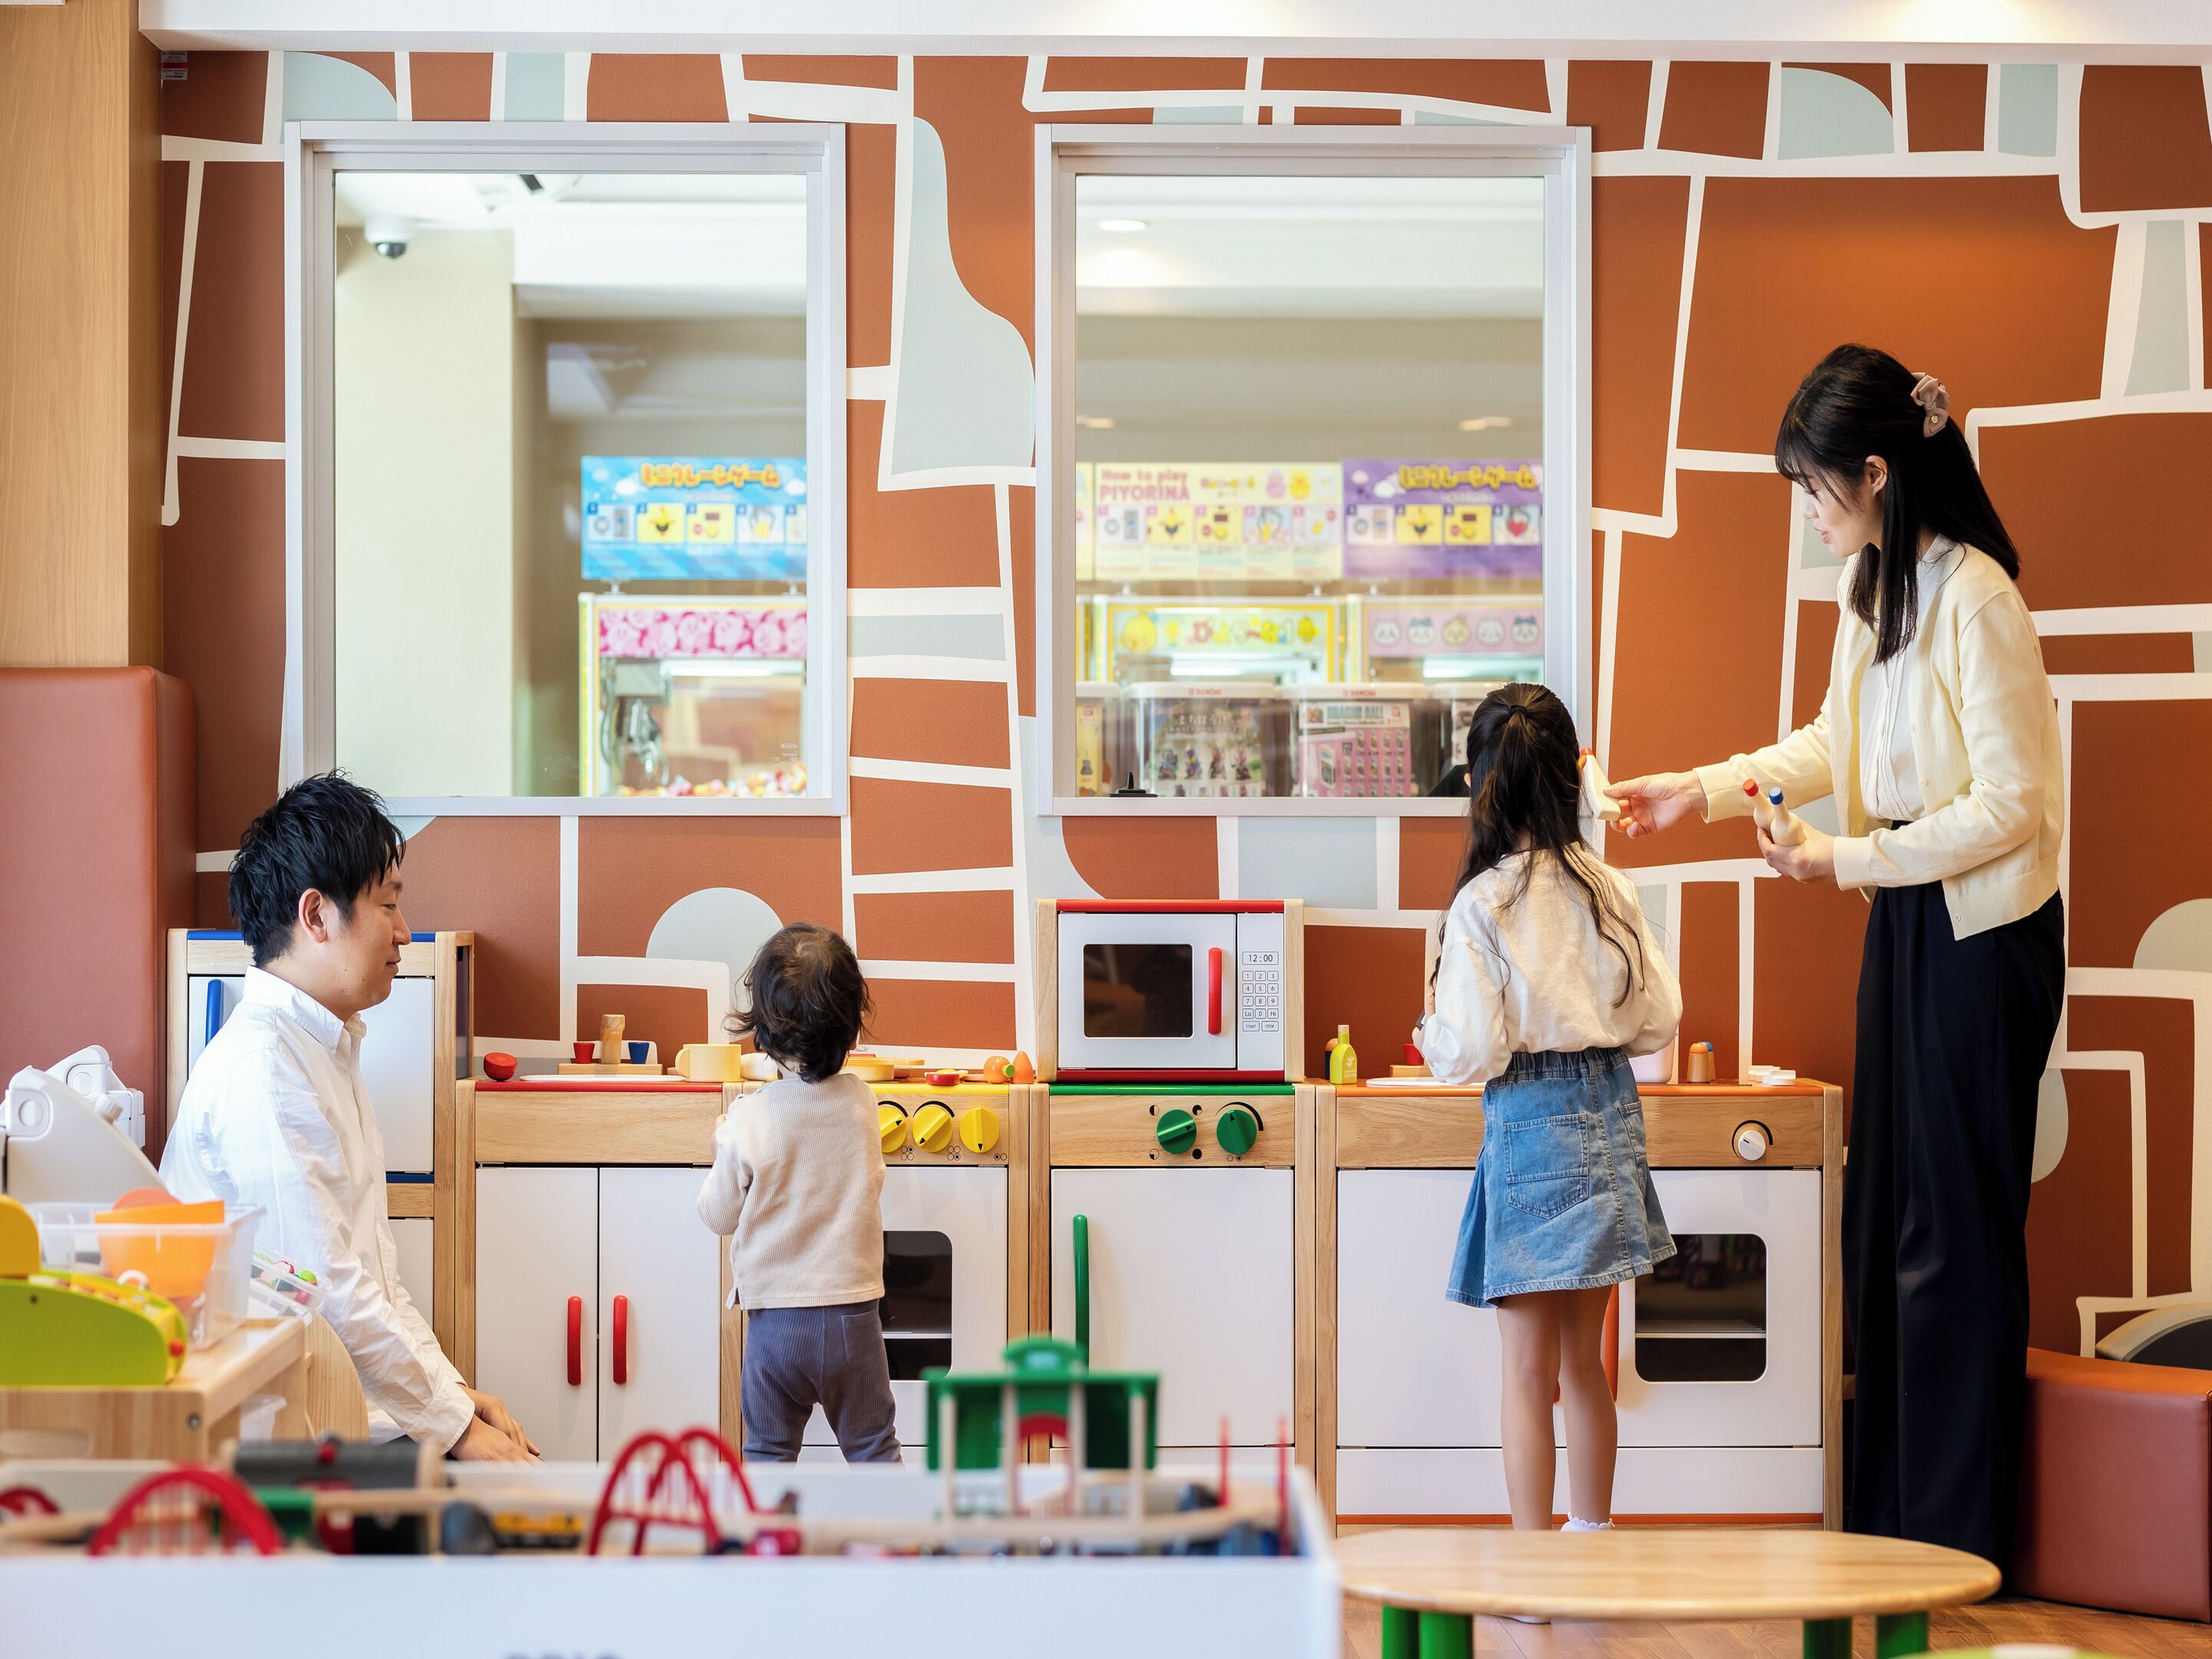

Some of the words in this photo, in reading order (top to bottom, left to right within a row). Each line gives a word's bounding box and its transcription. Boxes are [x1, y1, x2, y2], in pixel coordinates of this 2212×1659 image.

[1101, 469, 1131, 480] How
[1137, 469, 1152, 480] to
[1157, 468, 1187, 485] play
[1100, 485, 1190, 501] PIYORINA
